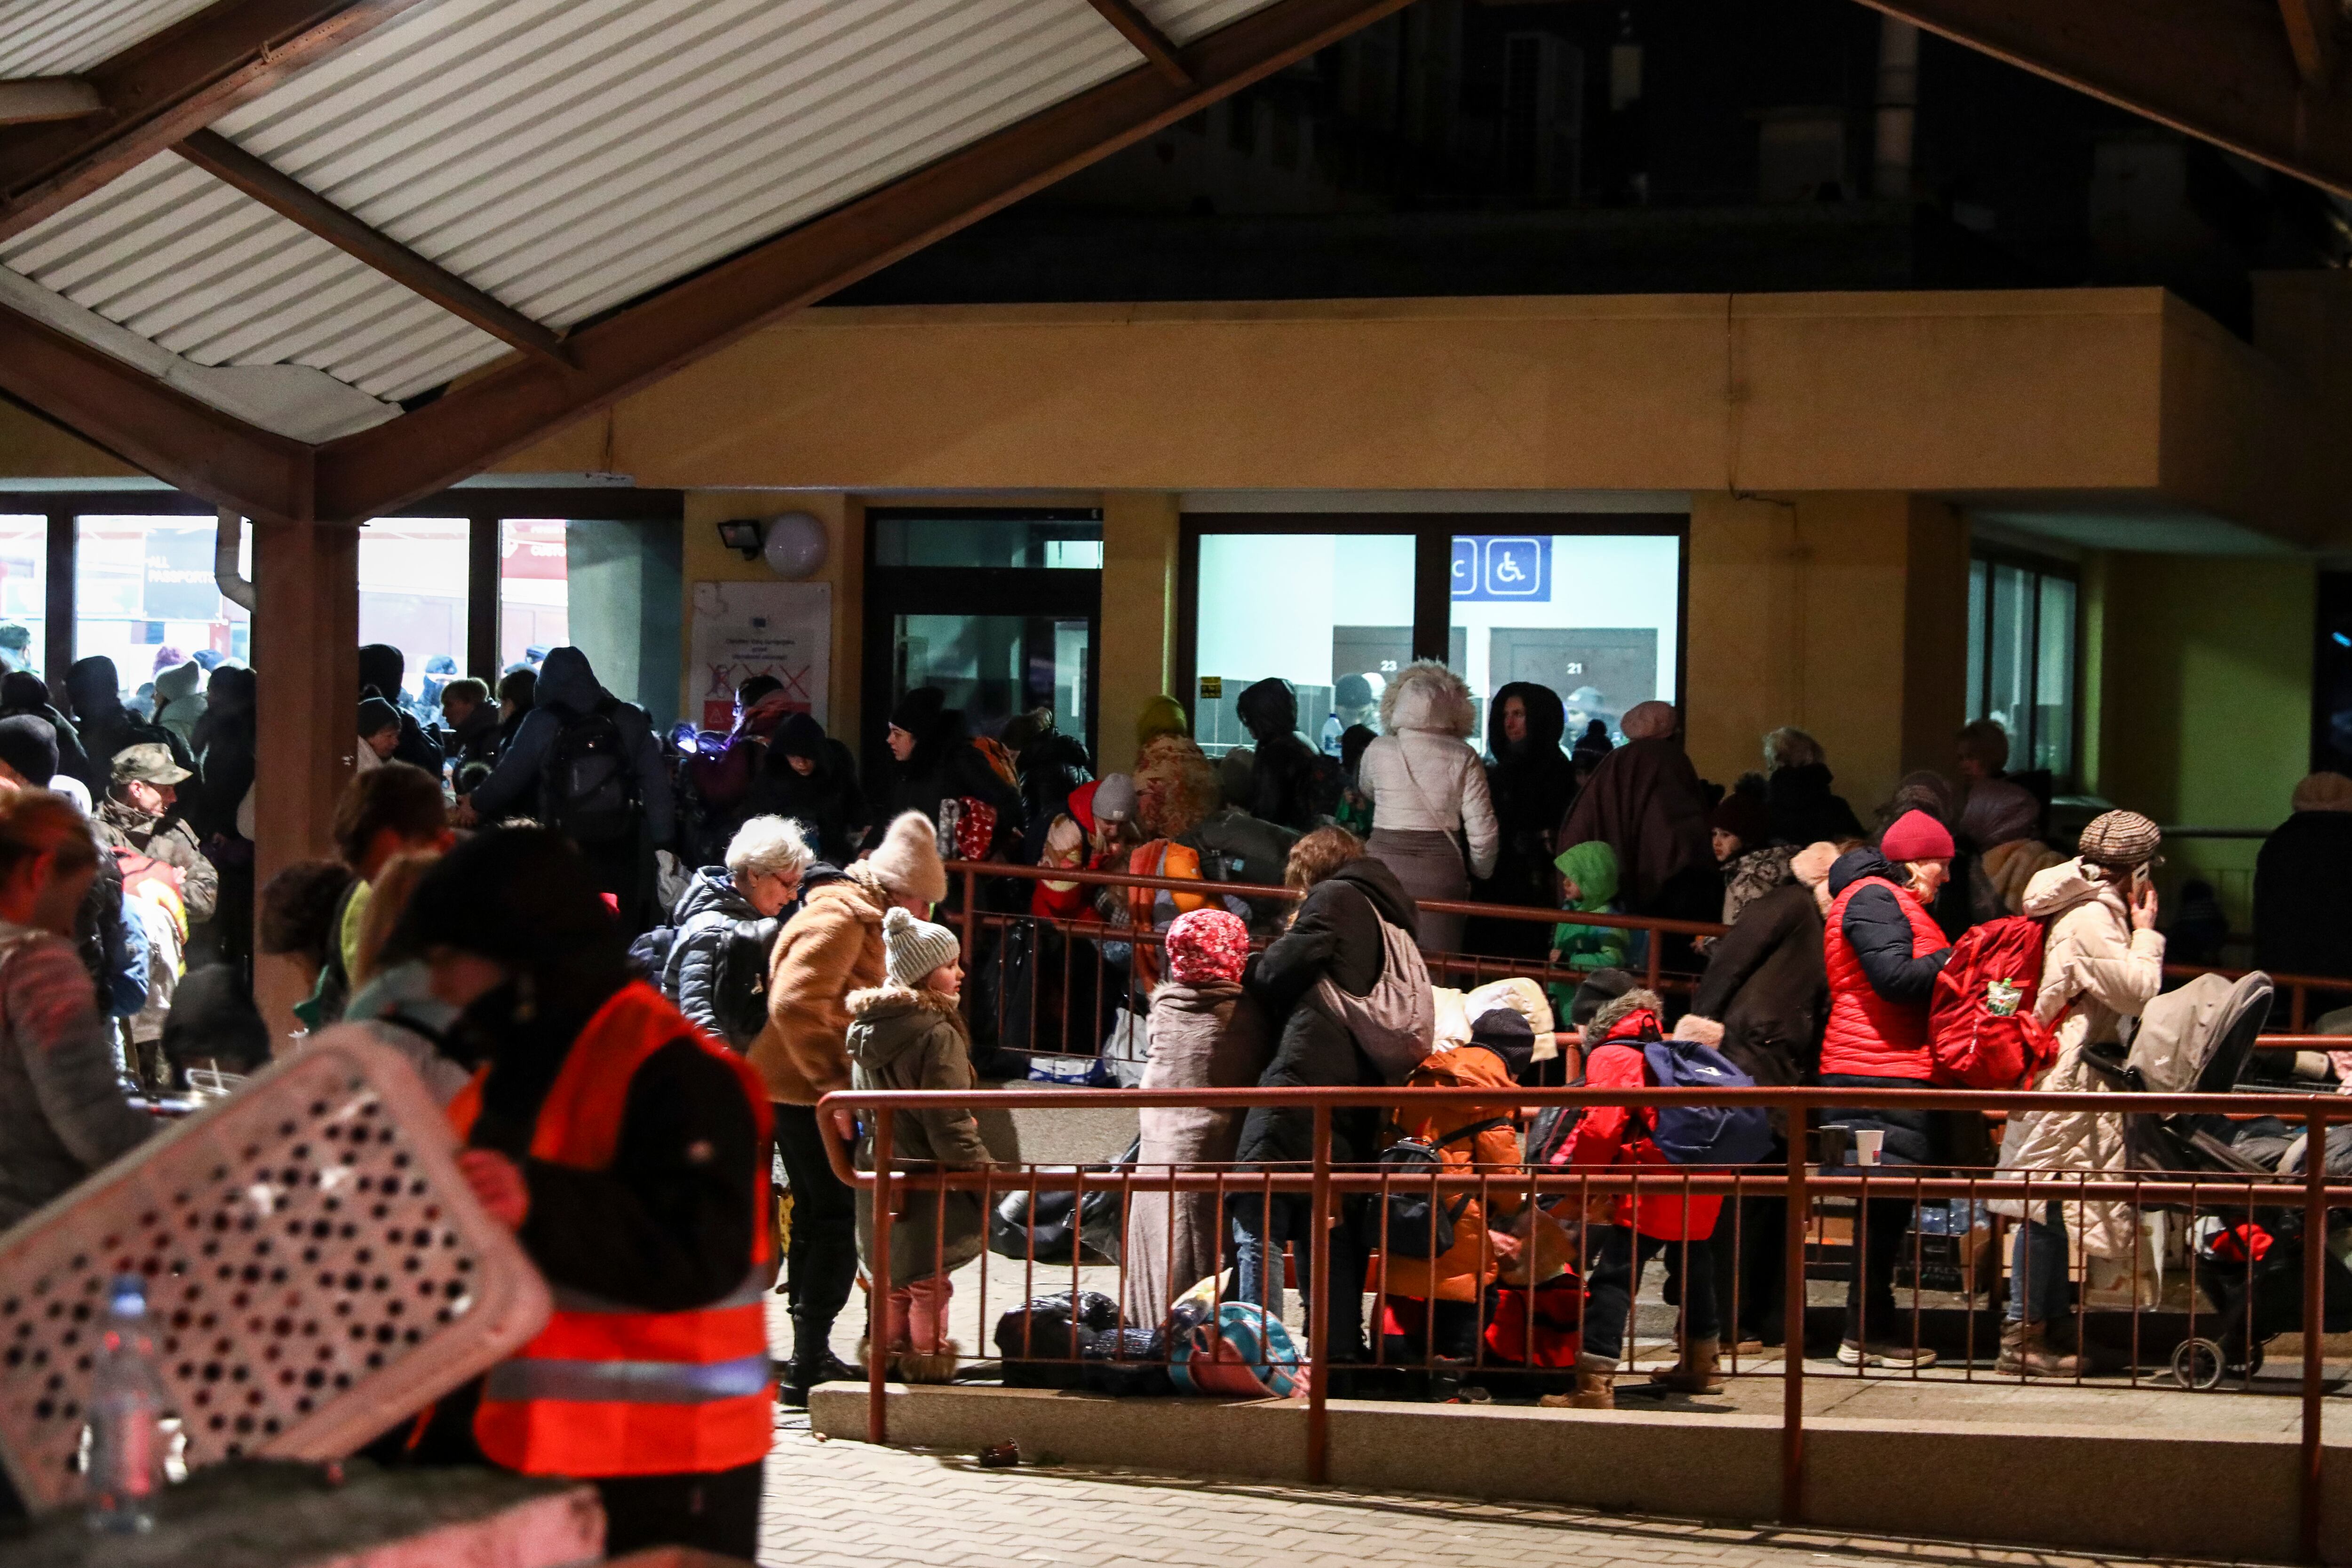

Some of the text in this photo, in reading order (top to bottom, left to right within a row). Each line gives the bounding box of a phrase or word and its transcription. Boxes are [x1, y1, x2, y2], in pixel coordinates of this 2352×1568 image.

[148, 555, 170, 569] ALL
[149, 570, 216, 584] PASSPORTS
[1381, 660, 1397, 672] 23
[1567, 662, 1582, 674] 21
